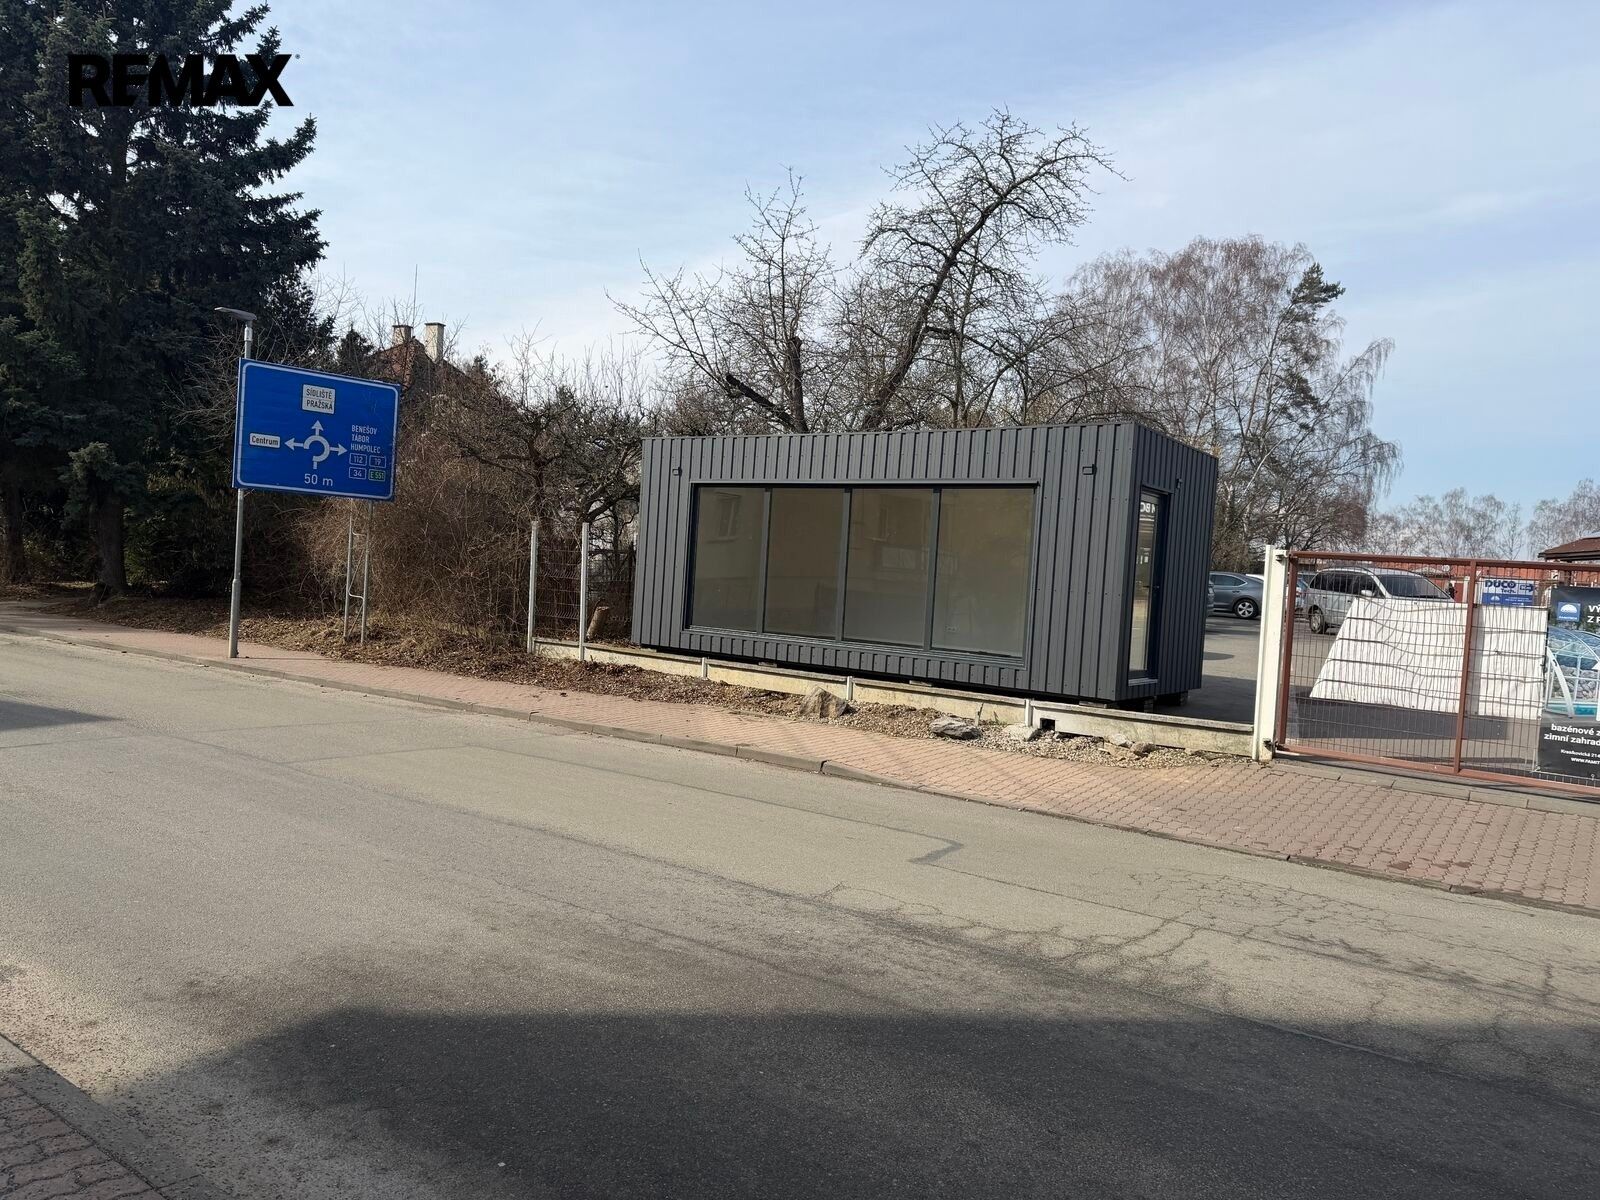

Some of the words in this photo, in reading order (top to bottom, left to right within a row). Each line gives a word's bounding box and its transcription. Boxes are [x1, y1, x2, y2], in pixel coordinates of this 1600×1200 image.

[306, 399, 333, 410] PRAŽSKÁ
[351, 424, 378, 435] BENEŠOV
[251, 435, 279, 446] Centrum
[350, 443, 381, 454] HUMPOLEC
[353, 455, 364, 464] 112
[353, 469, 362, 477] 34
[304, 473, 318, 485] 50
[322, 478, 333, 487] m
[1485, 580, 1516, 589] DUCO
[1551, 723, 1594, 735] bazénové
[1544, 733, 1569, 742] zimní
